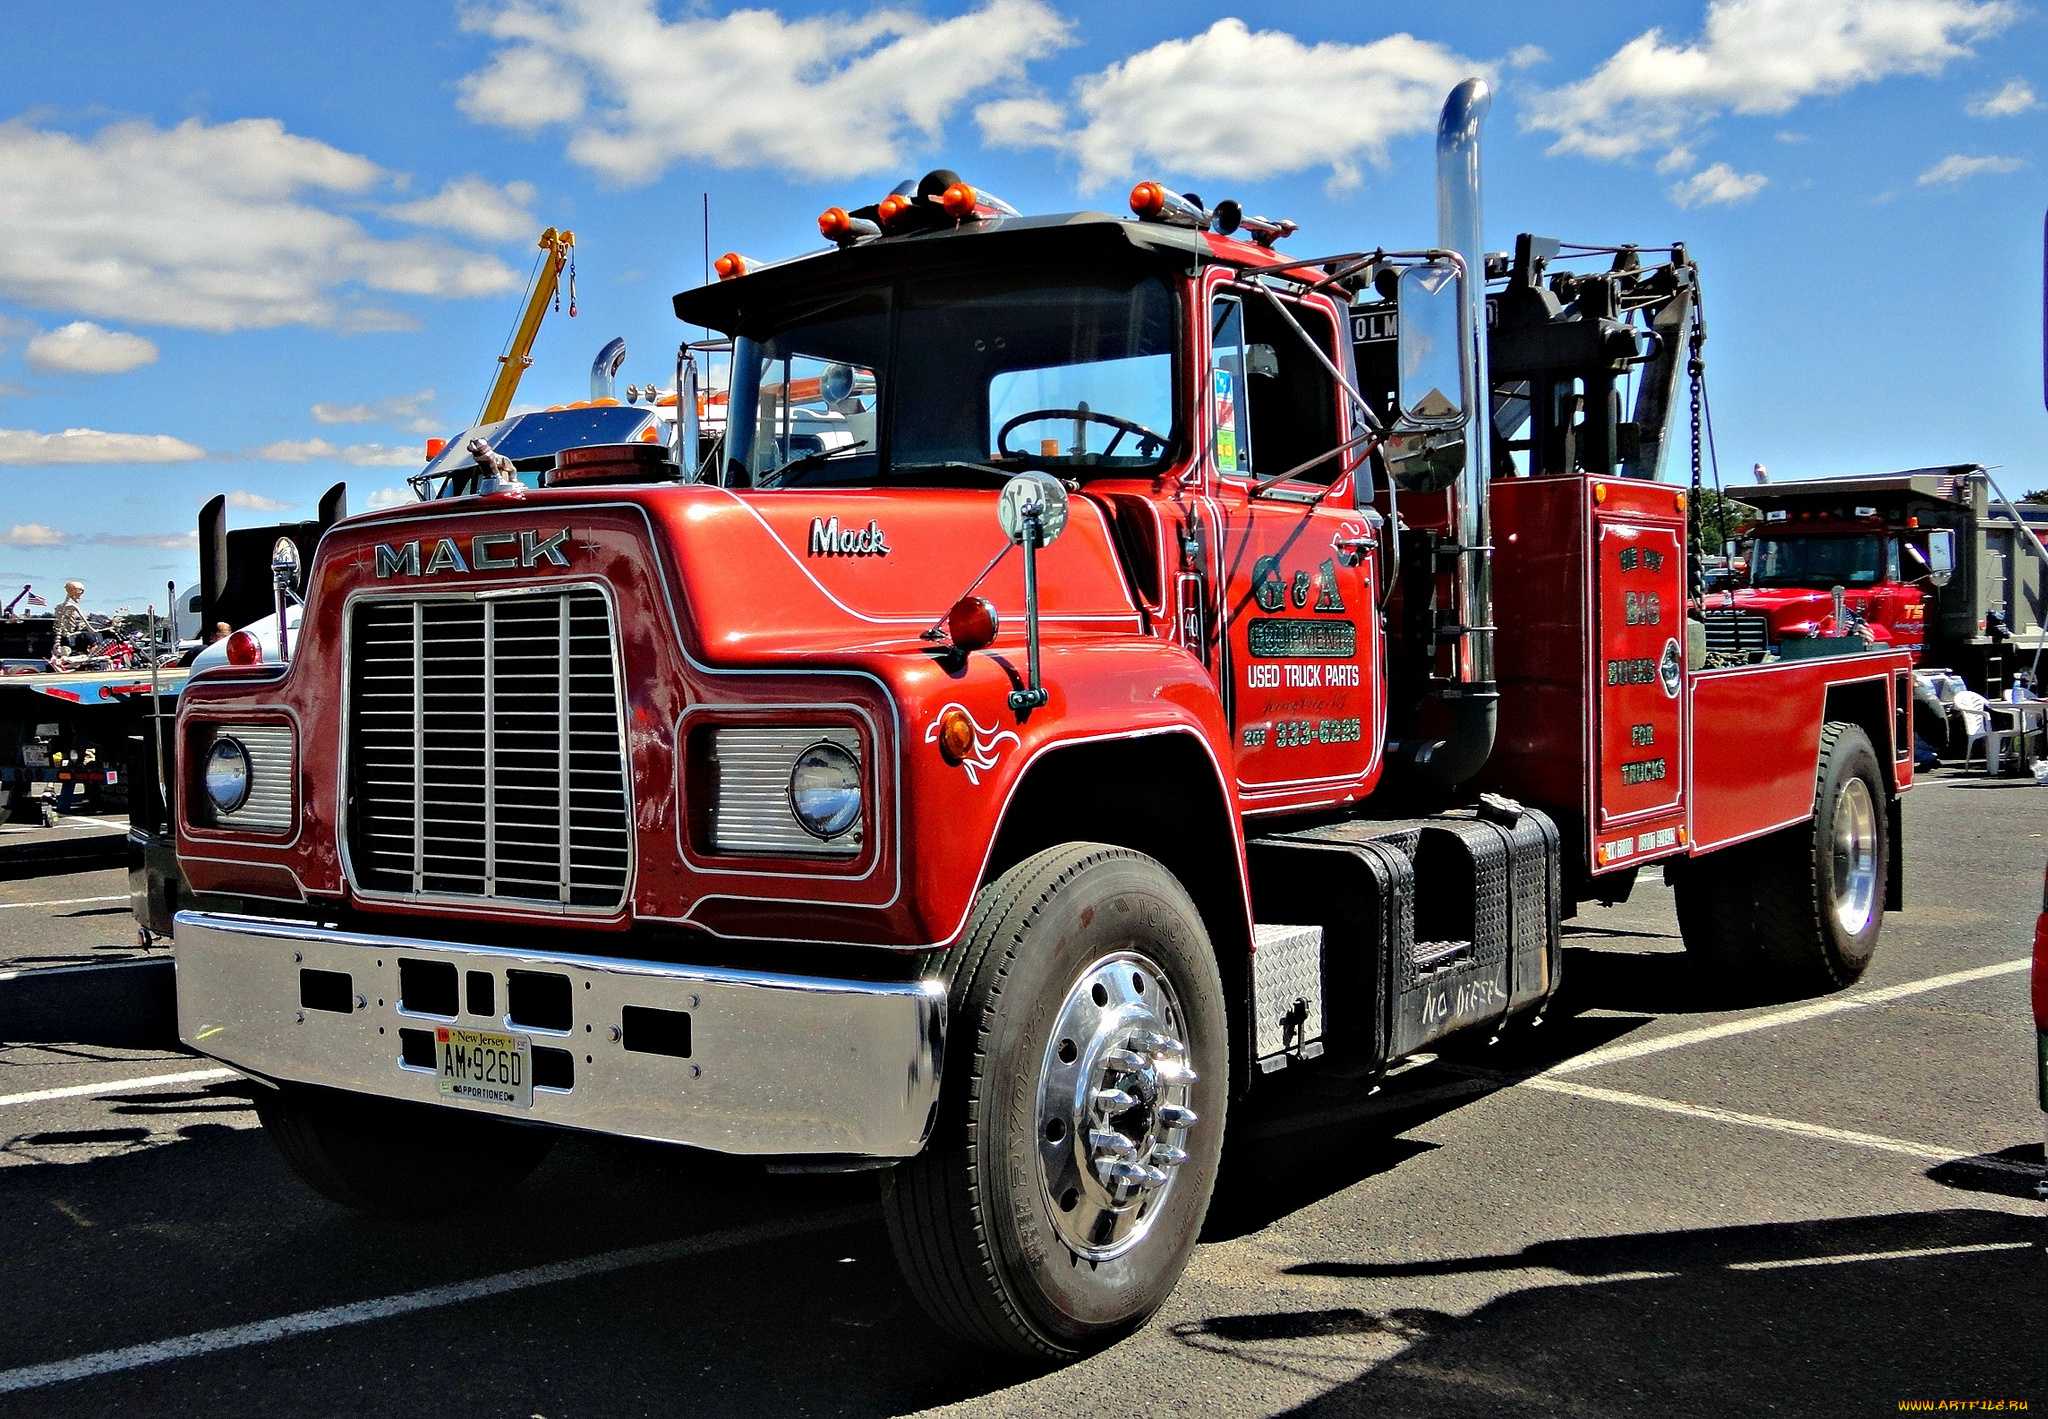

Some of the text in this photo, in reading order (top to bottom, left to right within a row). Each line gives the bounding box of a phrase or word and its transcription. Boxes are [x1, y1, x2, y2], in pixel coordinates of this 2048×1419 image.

[809, 516, 892, 556] Mack
[375, 526, 571, 578] MACK
[1252, 555, 1345, 613] G & A
[1625, 591, 1660, 626] BIG
[1248, 665, 1359, 688] USED TRUCK PARTS
[1608, 659, 1656, 686] BUCKS
[1275, 718, 1361, 748] 333-6225
[1631, 724, 1654, 747] FOR
[1622, 757, 1666, 786] TRUCKS
[1422, 987, 1448, 1024] NO
[457, 1031, 478, 1043] New
[478, 1033, 506, 1049] Jersey
[457, 1085, 509, 1101] APPORTIONED
